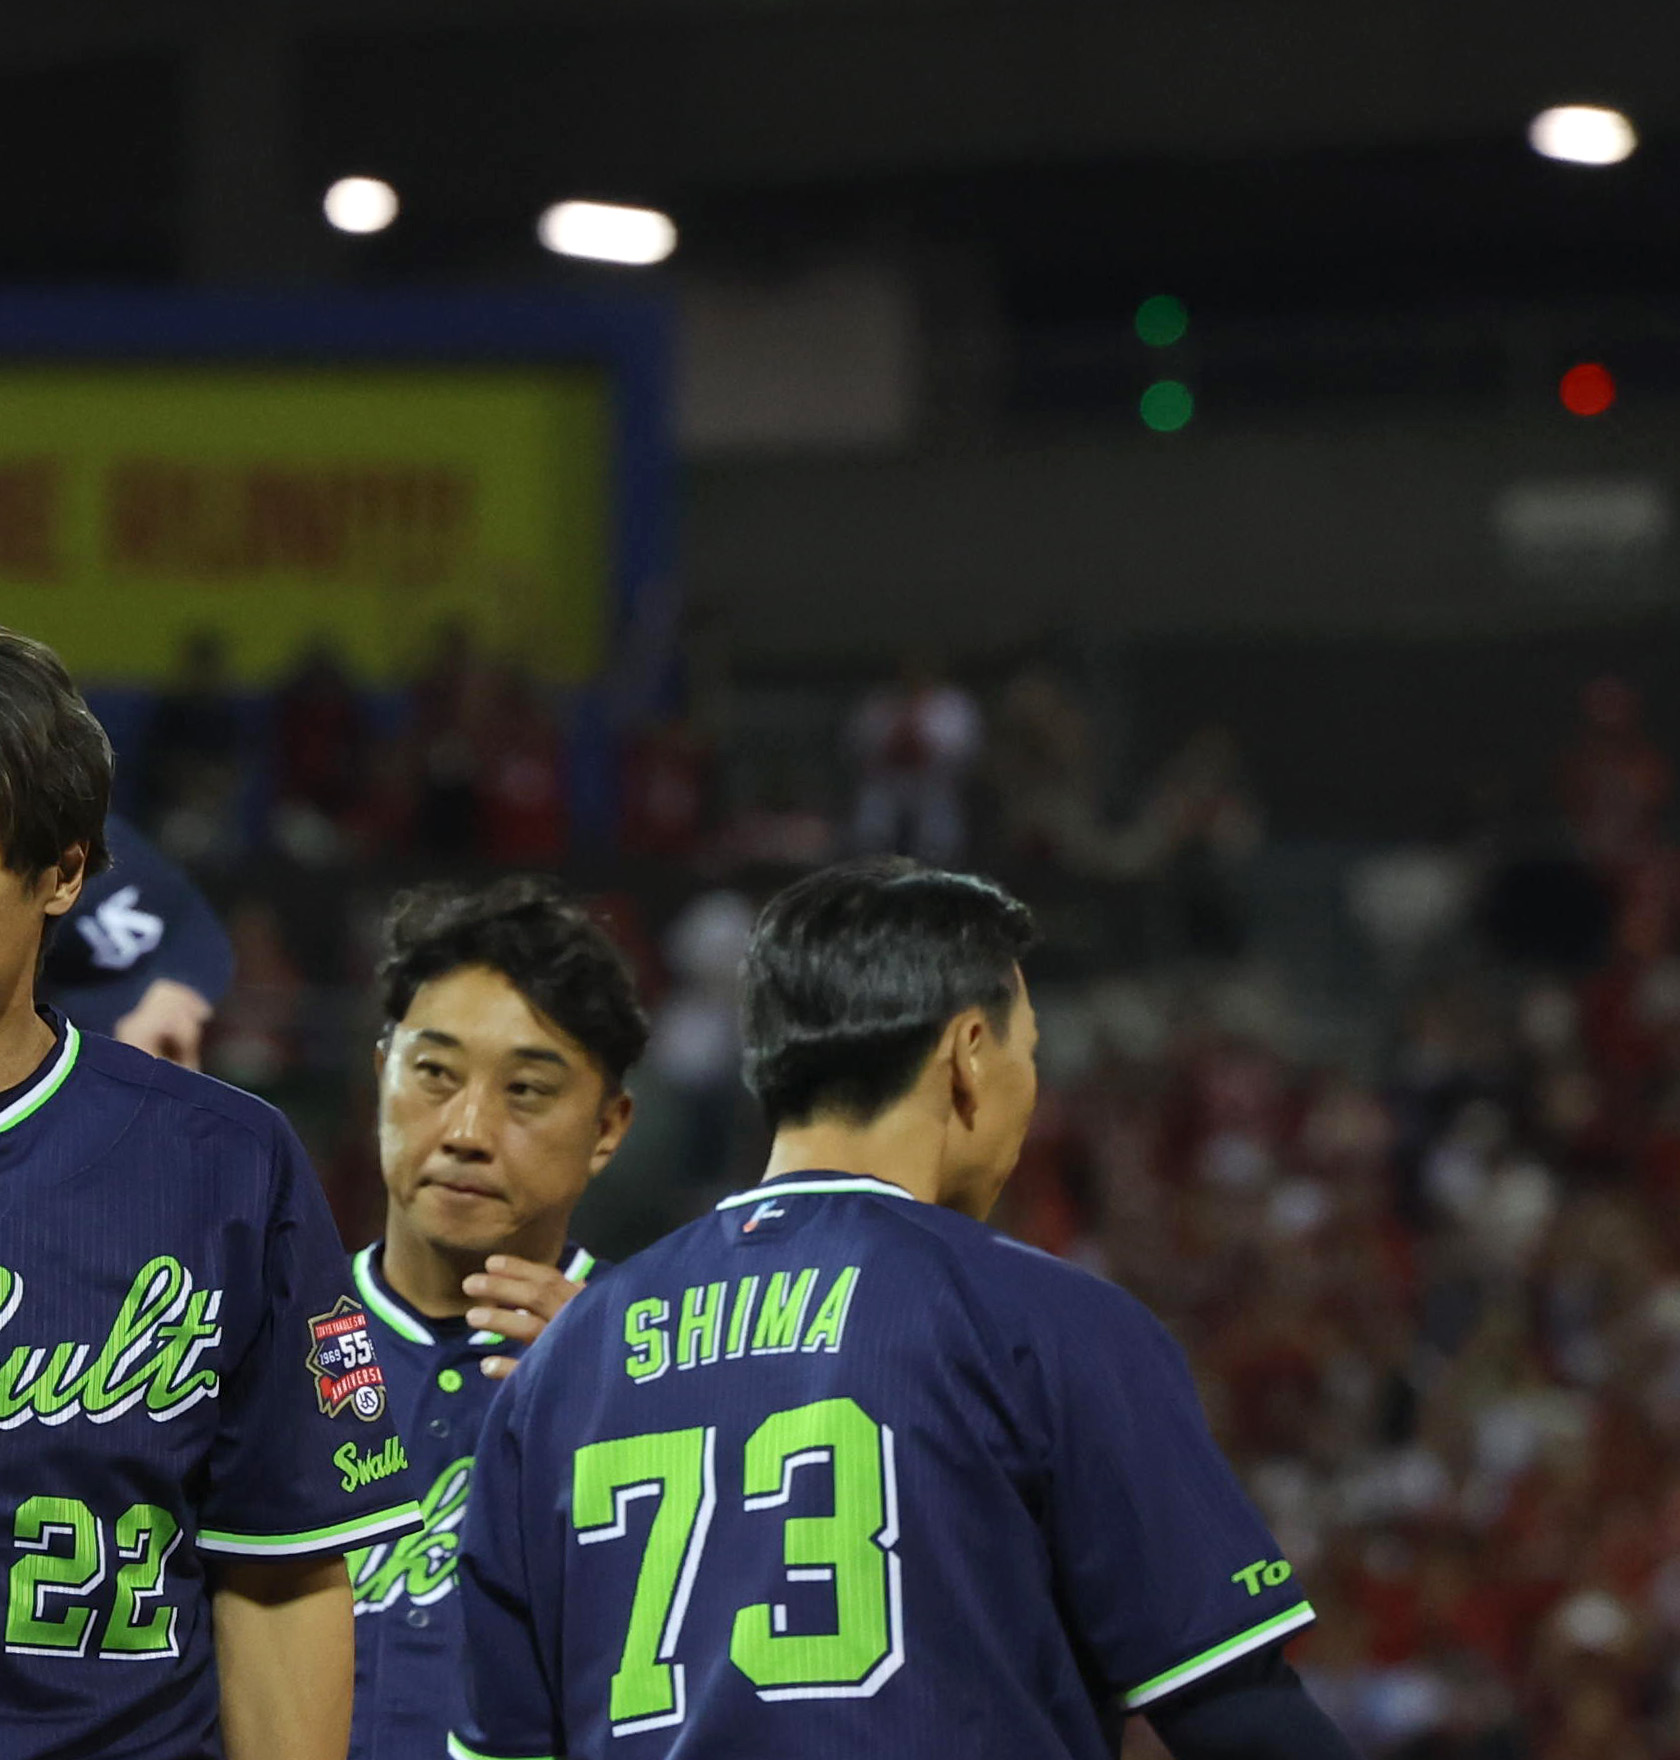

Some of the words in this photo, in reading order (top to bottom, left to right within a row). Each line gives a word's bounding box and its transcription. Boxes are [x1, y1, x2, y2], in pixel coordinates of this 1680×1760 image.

[320, 1348, 341, 1366] 1969
[338, 1330, 372, 1369] 55
[623, 1265, 861, 1385] SHIMA
[5, 1495, 183, 1660] 22
[572, 1397, 905, 1737] 73
